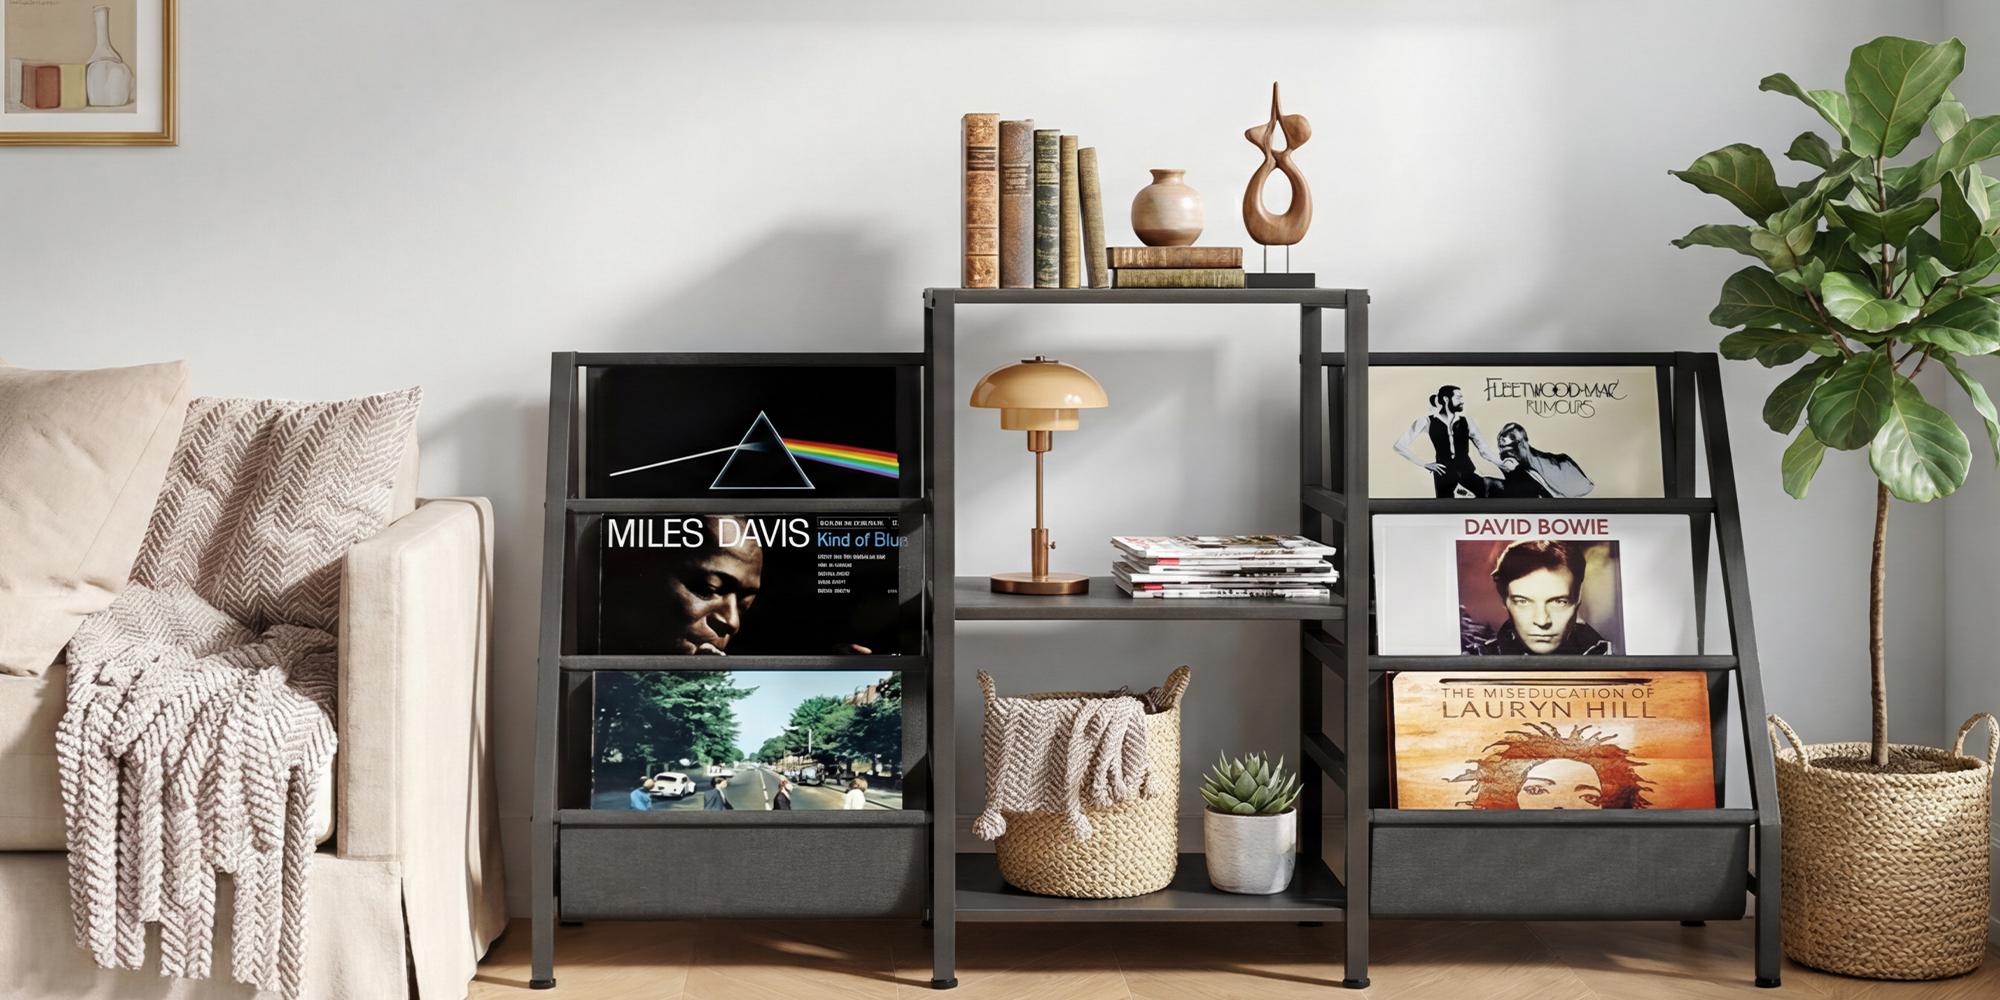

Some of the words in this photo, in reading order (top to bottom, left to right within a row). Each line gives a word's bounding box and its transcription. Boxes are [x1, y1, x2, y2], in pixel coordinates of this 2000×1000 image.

[1526, 399, 1596, 418] RUMOURS
[607, 518, 704, 548] MILES
[718, 517, 811, 548] DAVIS
[1464, 518, 1532, 535] DAVID
[1538, 518, 1609, 535] BOWIE
[817, 532, 850, 547] Kind
[854, 532, 871, 547] of
[1441, 687, 1475, 699] THE
[1483, 687, 1625, 699] MISEDUCATION
[1631, 687, 1655, 699] OF
[1442, 700, 1572, 719] LAURYN
[1586, 700, 1657, 719] HILL
